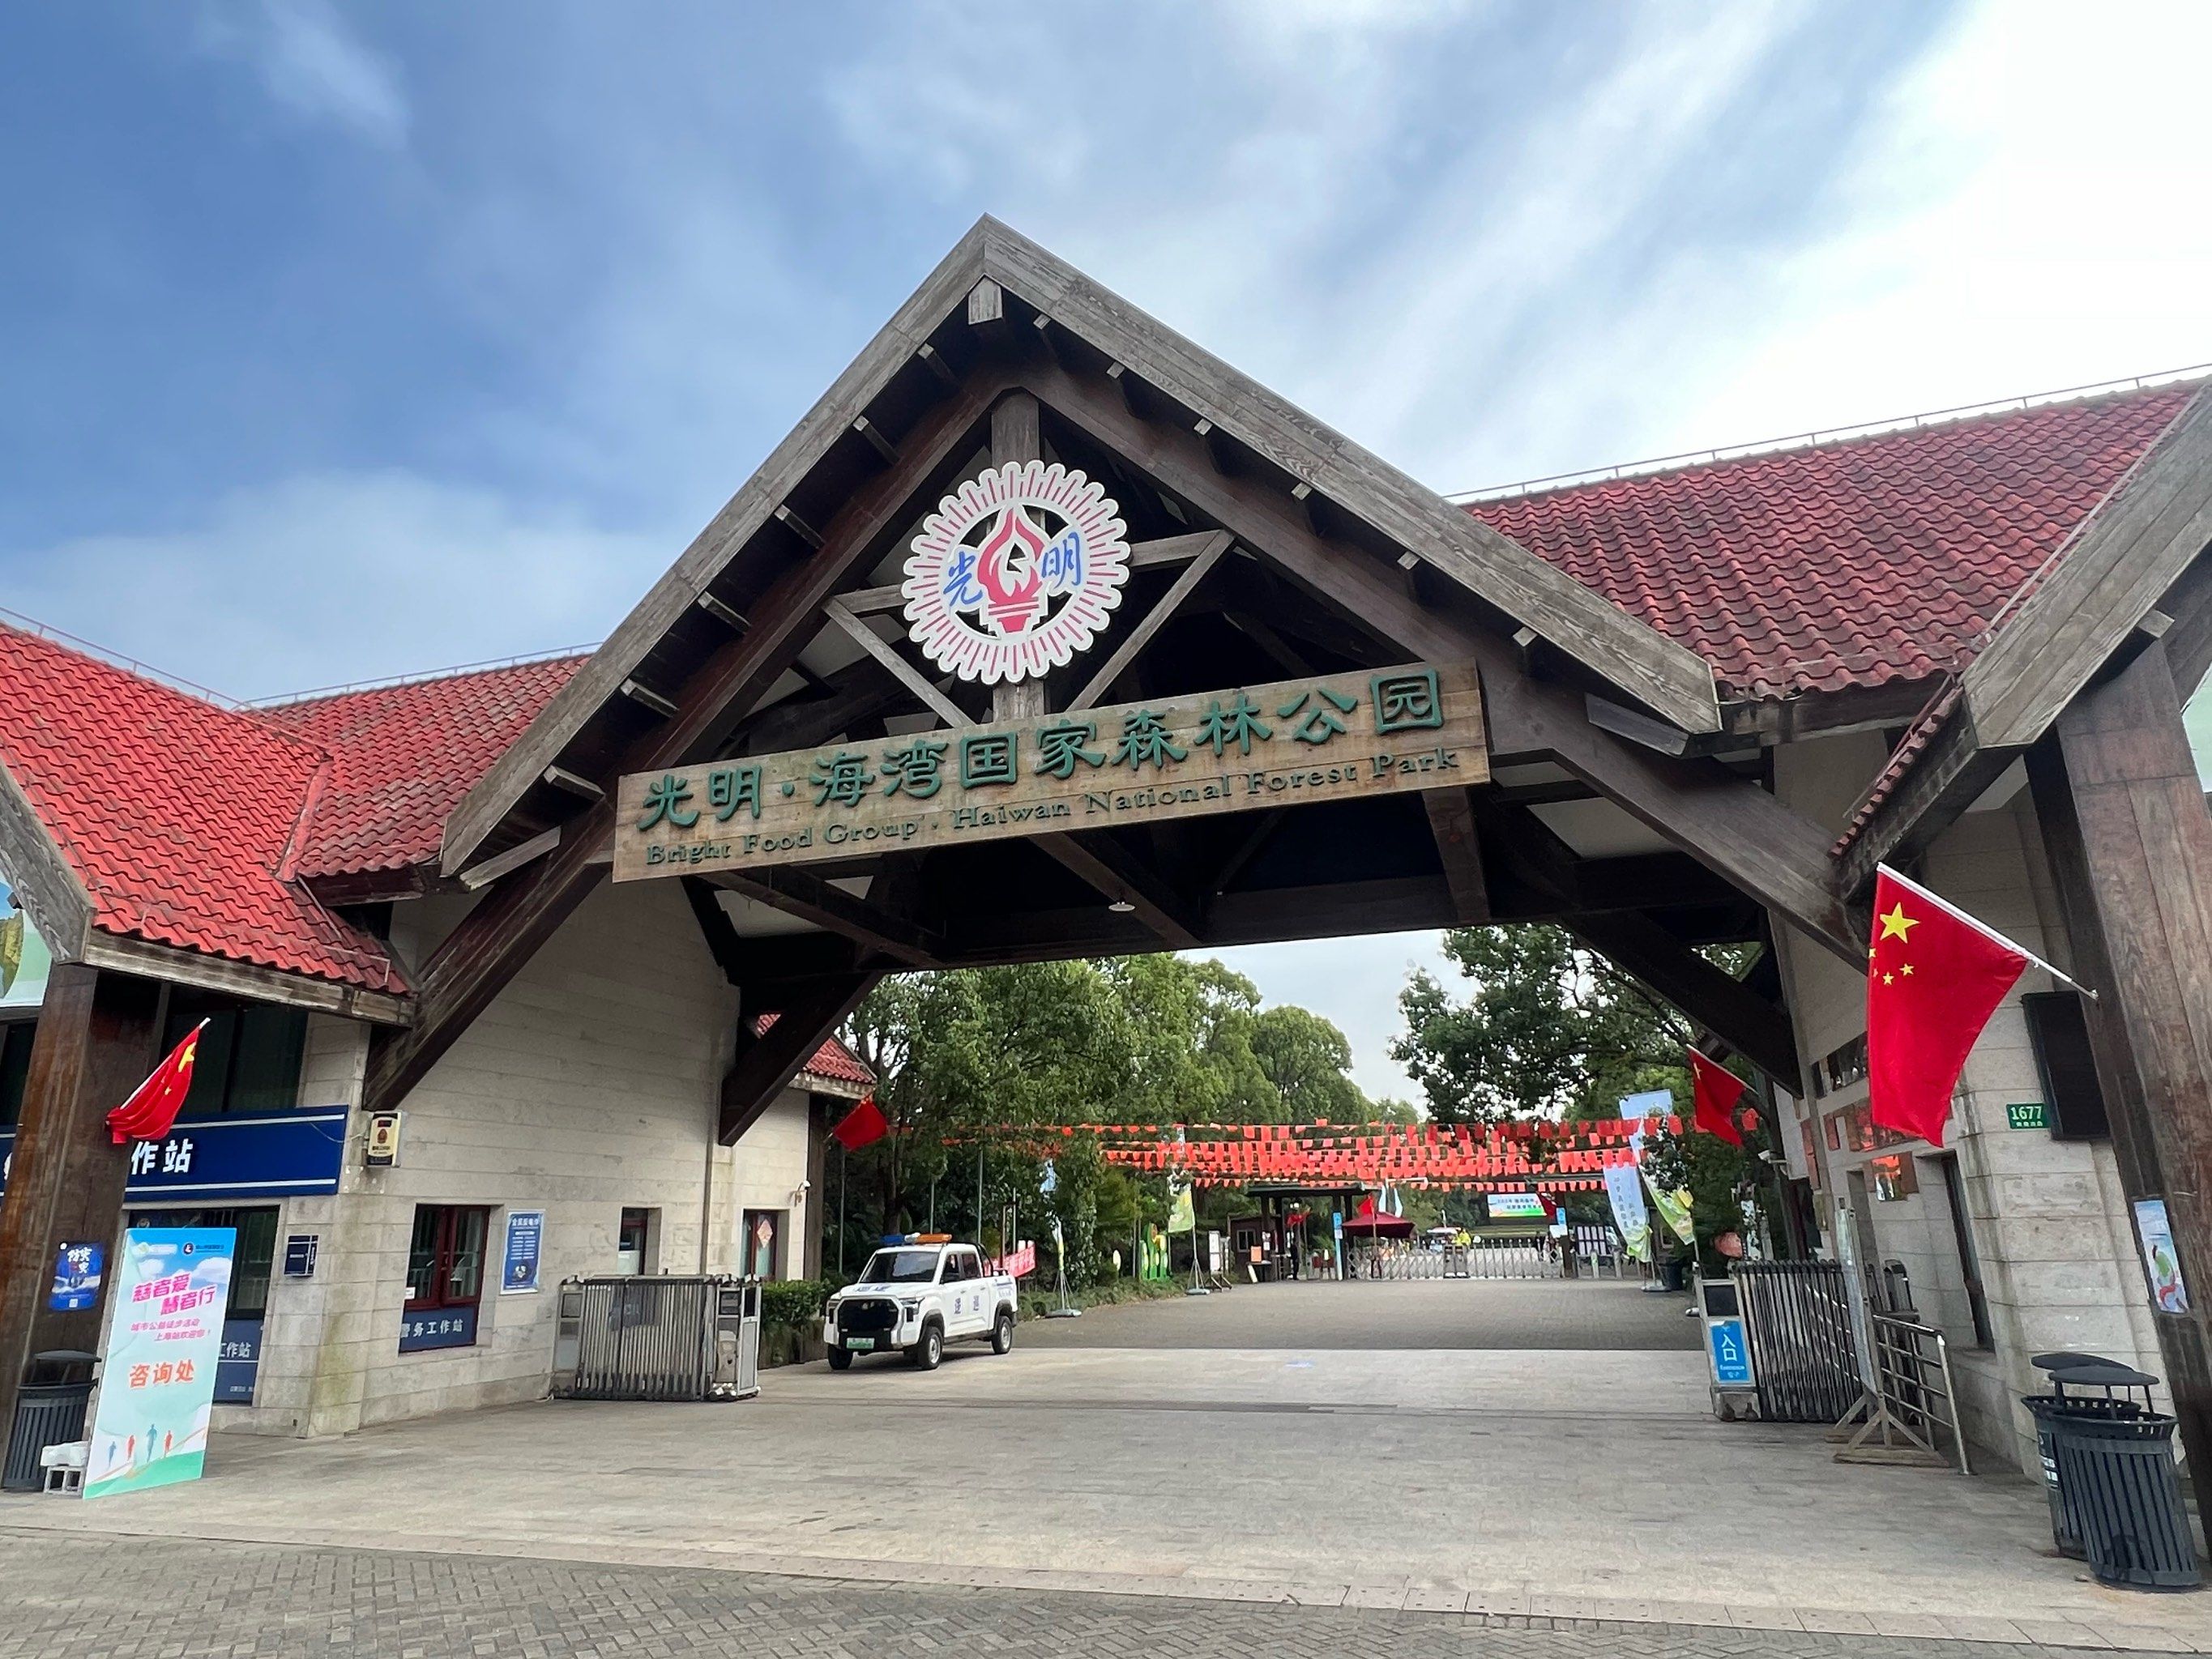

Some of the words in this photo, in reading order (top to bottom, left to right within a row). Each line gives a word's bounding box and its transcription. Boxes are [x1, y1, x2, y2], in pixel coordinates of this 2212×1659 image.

[637, 668, 1444, 831] 光明·海湾国家森林公园
[646, 840, 731, 865] Bright
[743, 826, 813, 855] Food
[823, 817, 920, 846] Group
[952, 801, 1071, 830] Haiwan
[1083, 773, 1232, 814] National
[1248, 764, 1356, 795] Forest
[1371, 745, 1458, 778] Park
[2010, 1106, 2042, 1120] 1677
[1721, 1333, 1738, 1362] 入口
[130, 1358, 194, 1388] 咨询处
